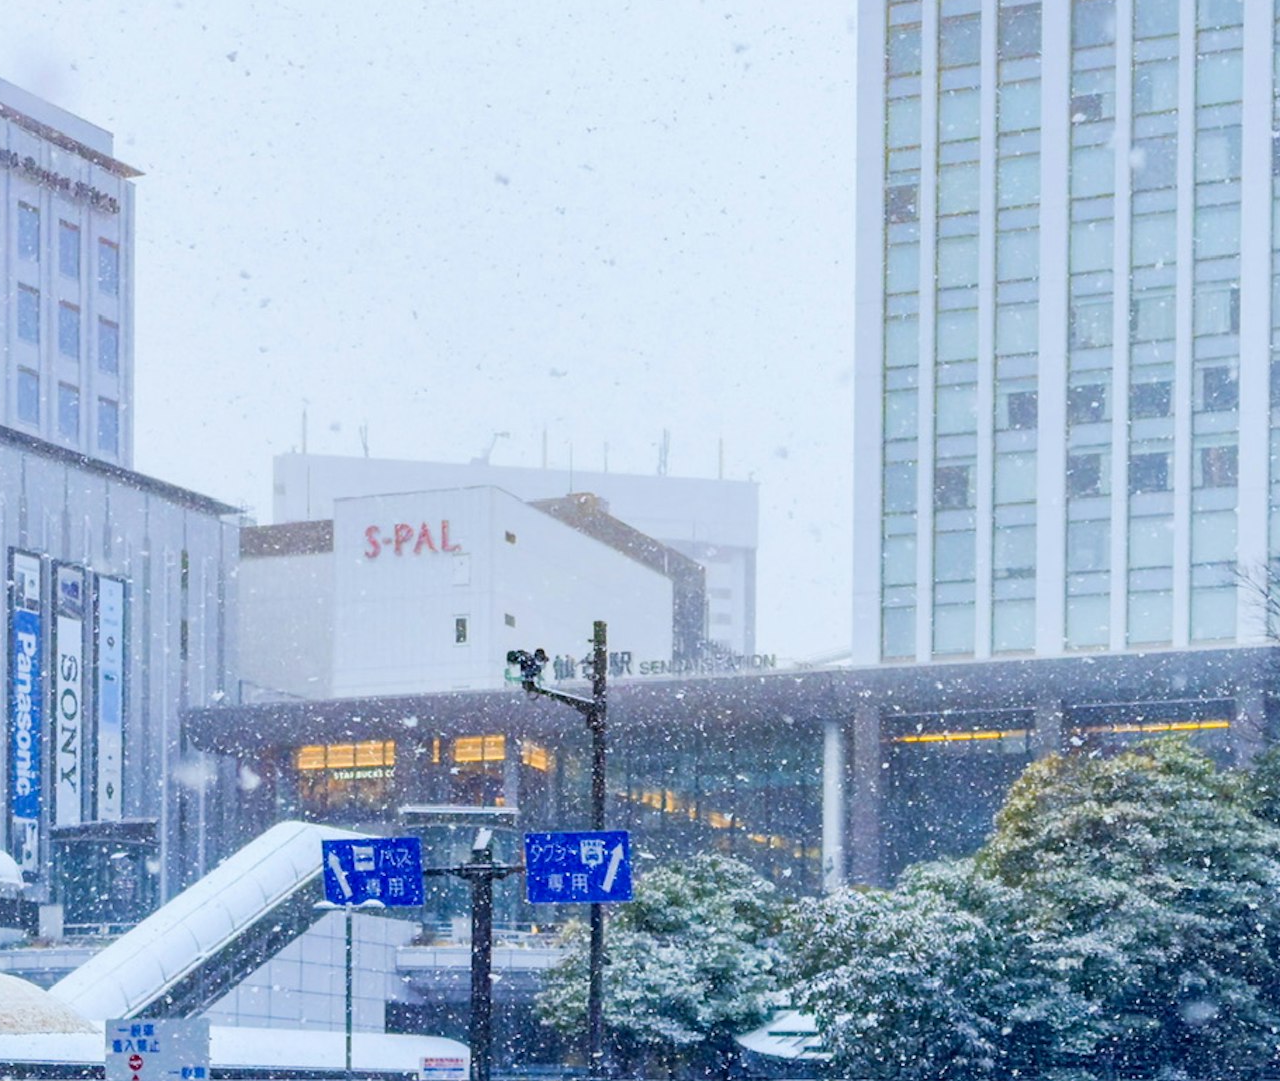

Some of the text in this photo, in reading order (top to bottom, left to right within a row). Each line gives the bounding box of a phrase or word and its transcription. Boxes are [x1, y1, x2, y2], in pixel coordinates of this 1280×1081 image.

[365, 520, 462, 558] S-PAL
[16, 631, 37, 797] Panasonic
[61, 654, 78, 794] SONY
[379, 849, 412, 868] バス
[367, 877, 405, 897] 専用
[547, 874, 589, 894] 専用
